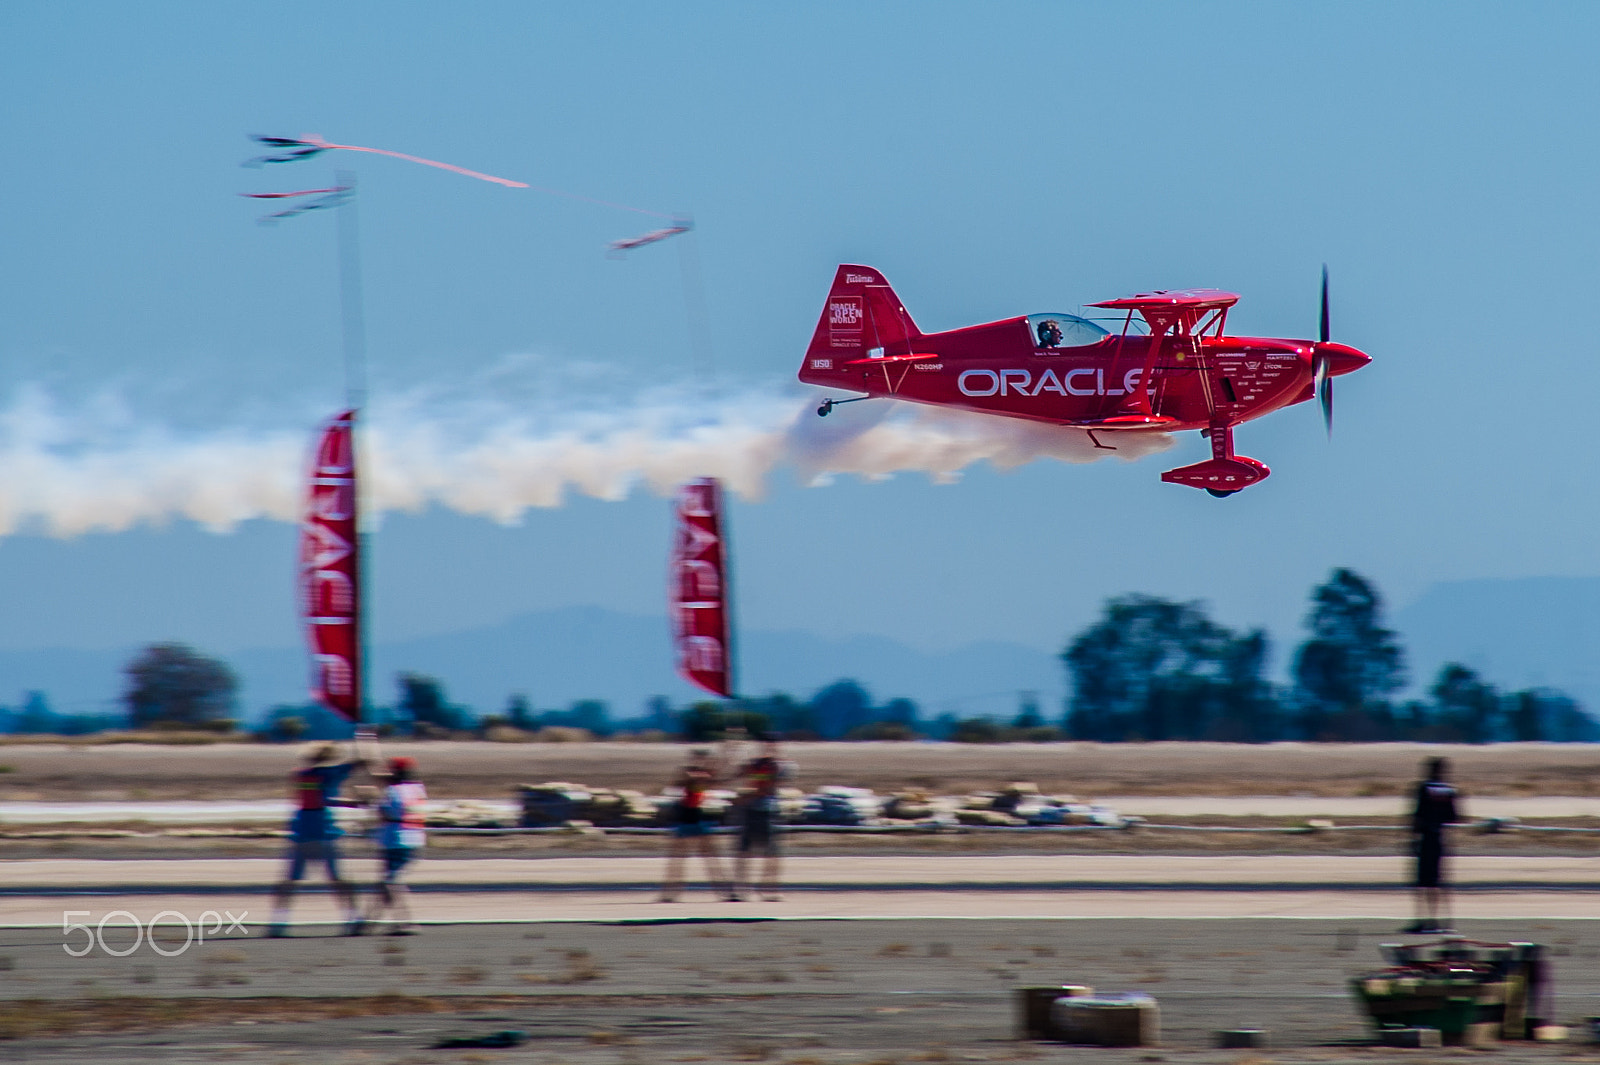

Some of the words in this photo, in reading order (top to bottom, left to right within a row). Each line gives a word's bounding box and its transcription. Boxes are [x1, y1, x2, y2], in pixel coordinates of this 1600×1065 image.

[830, 303, 857, 311] ORACLE
[835, 308, 863, 318] OPEN
[830, 316, 857, 324] WORLD
[814, 359, 830, 368] USO
[957, 368, 1156, 397] ORACLE
